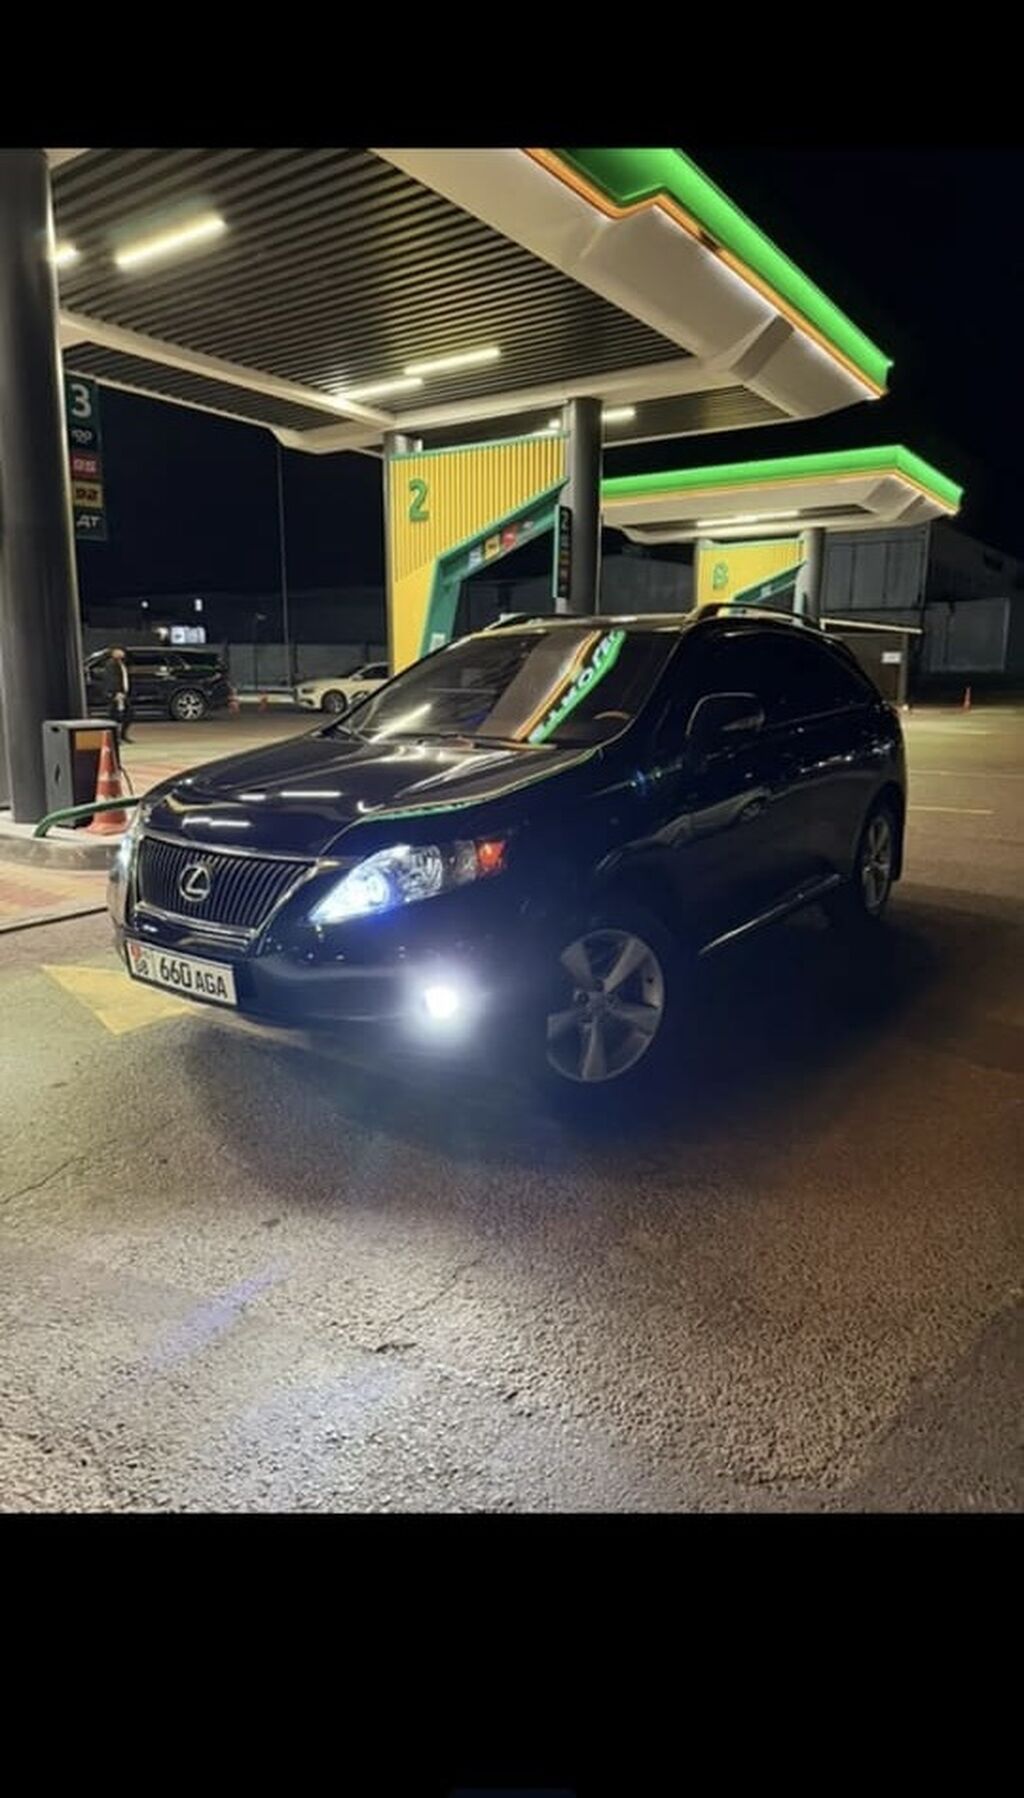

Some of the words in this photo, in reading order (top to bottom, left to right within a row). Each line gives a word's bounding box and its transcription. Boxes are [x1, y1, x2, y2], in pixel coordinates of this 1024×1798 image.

[71, 384, 91, 418] 3
[409, 479, 429, 523] 2
[76, 514, 99, 528] ДТ
[160, 957, 192, 988] 660
[195, 970, 228, 998] AGA
